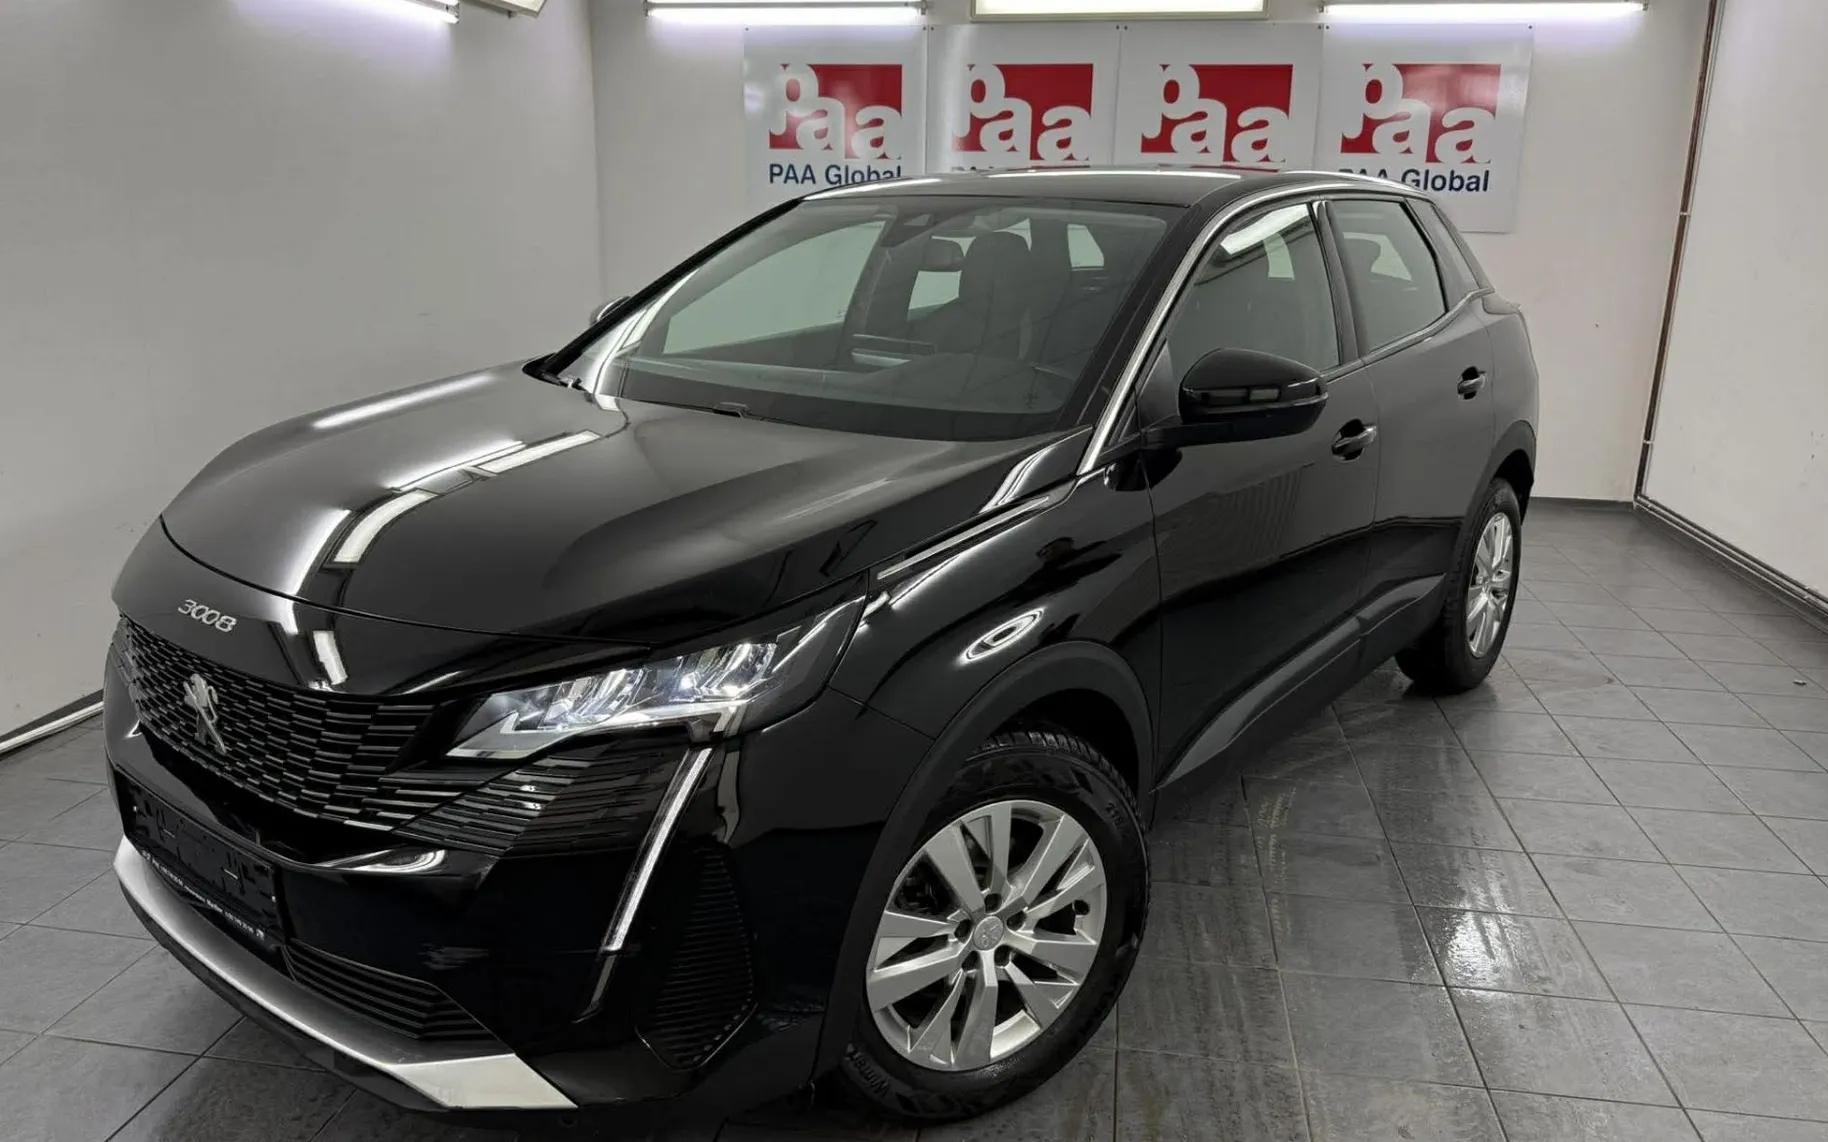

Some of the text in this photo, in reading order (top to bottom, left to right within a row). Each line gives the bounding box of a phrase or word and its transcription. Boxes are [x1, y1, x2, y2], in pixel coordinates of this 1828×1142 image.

[769, 163, 816, 184] PAA
[1401, 168, 1490, 192] Global
[178, 599, 237, 632] 3008
